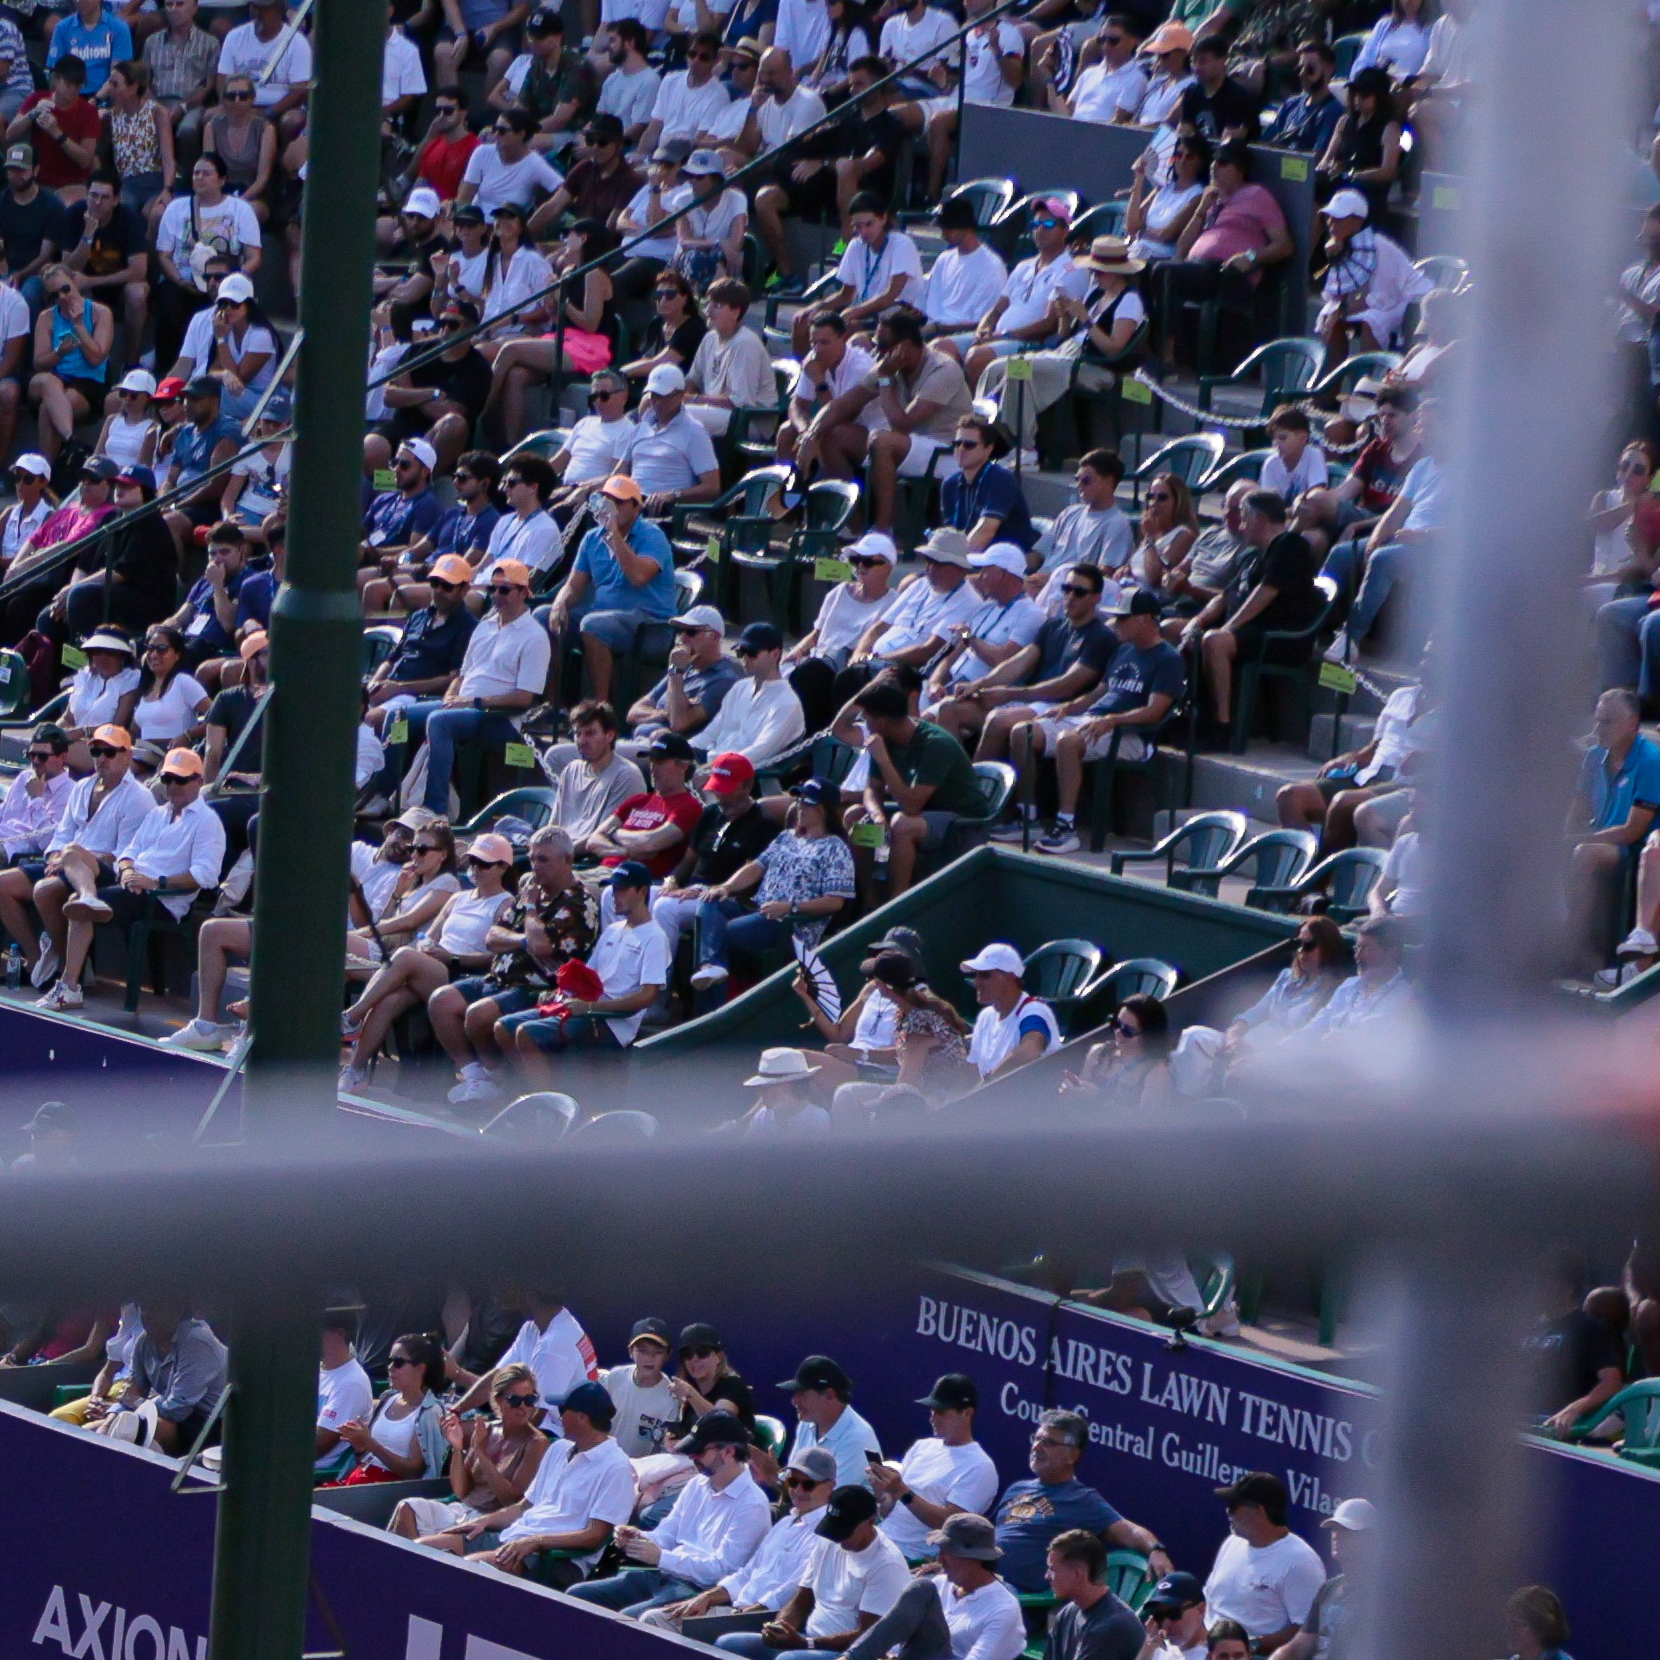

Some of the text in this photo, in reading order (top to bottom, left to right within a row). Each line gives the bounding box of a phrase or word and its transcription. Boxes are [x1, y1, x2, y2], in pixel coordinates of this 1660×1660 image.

[916, 1294, 1037, 1367] BUENOS
[1042, 1335, 1133, 1395] AIRES
[1139, 1362, 1231, 1427] LAWN
[1238, 1390, 1353, 1463] TENNIS
[1000, 1381, 1063, 1424] Cou
